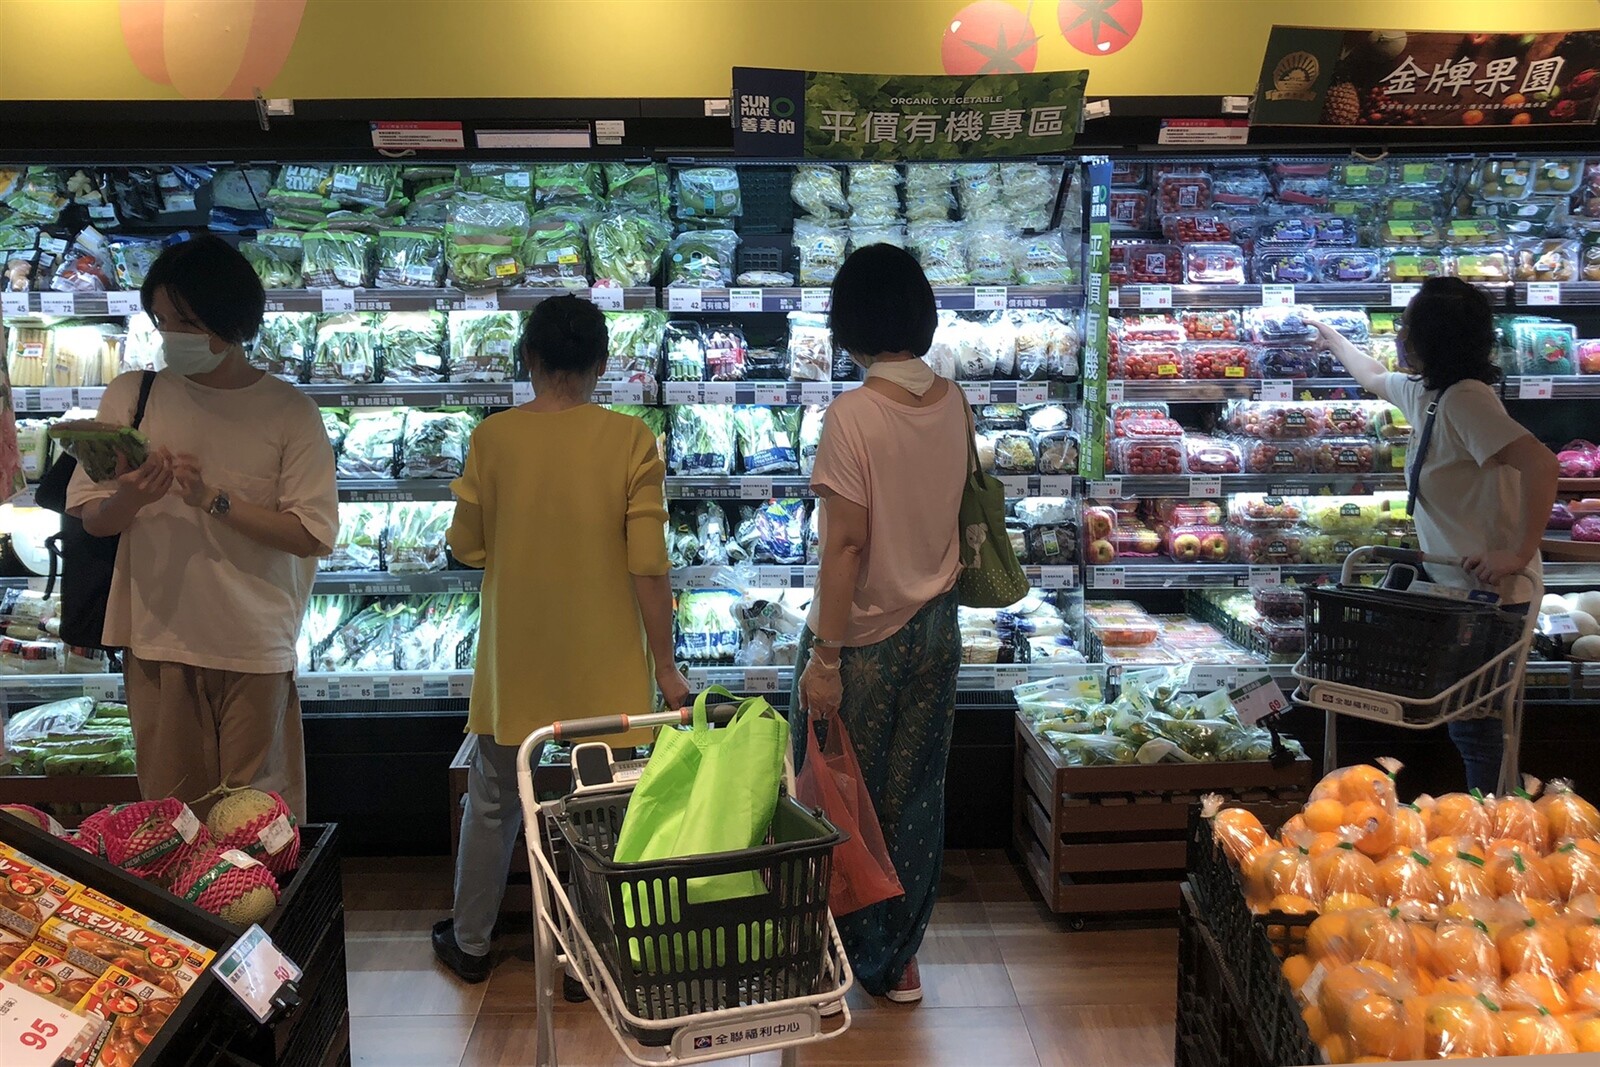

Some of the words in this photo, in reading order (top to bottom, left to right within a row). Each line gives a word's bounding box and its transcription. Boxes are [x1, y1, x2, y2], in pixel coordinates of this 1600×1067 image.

[1379, 54, 1566, 98] 金牌果園
[741, 95, 770, 108] SUN
[890, 96, 941, 106] ORGANIC
[942, 95, 1003, 106] VEGETABLE
[741, 108, 769, 117] MAKE
[741, 117, 795, 135] 善美的
[819, 104, 1068, 144] 平價有機專區
[129, 303, 138, 312] 52
[344, 302, 352, 310] 39
[486, 302, 494, 310] 39
[612, 302, 620, 310] 39
[1006, 299, 1047, 307] 價有機專區
[17, 304, 26, 312] 45
[62, 304, 72, 312] 72
[1216, 679, 1224, 687] 95
[105, 690, 114, 699] 68
[316, 689, 326, 697] 28
[362, 688, 370, 696] 85
[1268, 699, 1281, 712] 69
[1335, 697, 1390, 714] 全聯福利中心
[61, 904, 158, 946] バーモントカレー
[272, 966, 291, 982] 50
[20, 1018, 58, 1050] 95
[714, 1022, 800, 1046] 全聯福利中心
